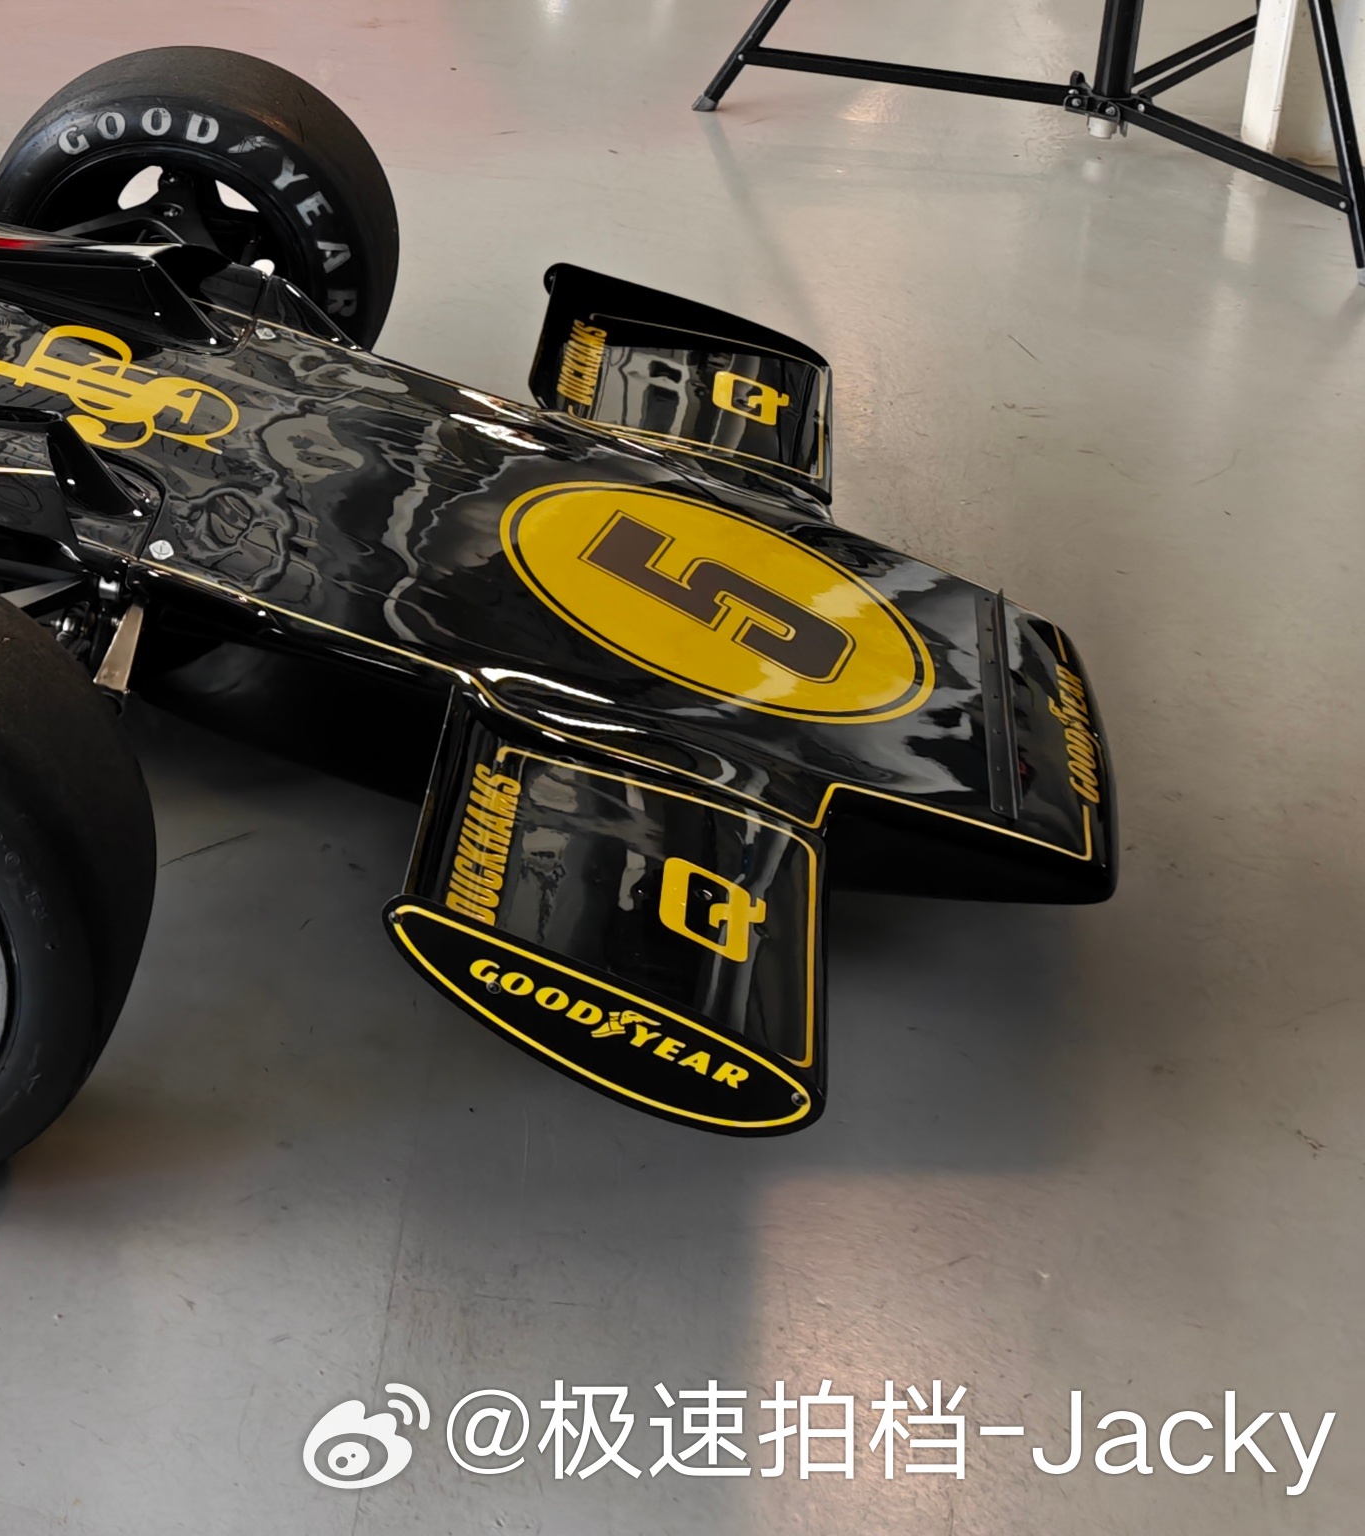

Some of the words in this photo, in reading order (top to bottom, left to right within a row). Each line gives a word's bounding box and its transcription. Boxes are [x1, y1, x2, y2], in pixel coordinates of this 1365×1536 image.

[556, 319, 608, 406] DUCKHAMS
[576, 509, 857, 684] 5
[445, 763, 521, 927] DUCKHAMS
[659, 856, 767, 963] Q
[470, 958, 750, 1089] GOODYEAR
